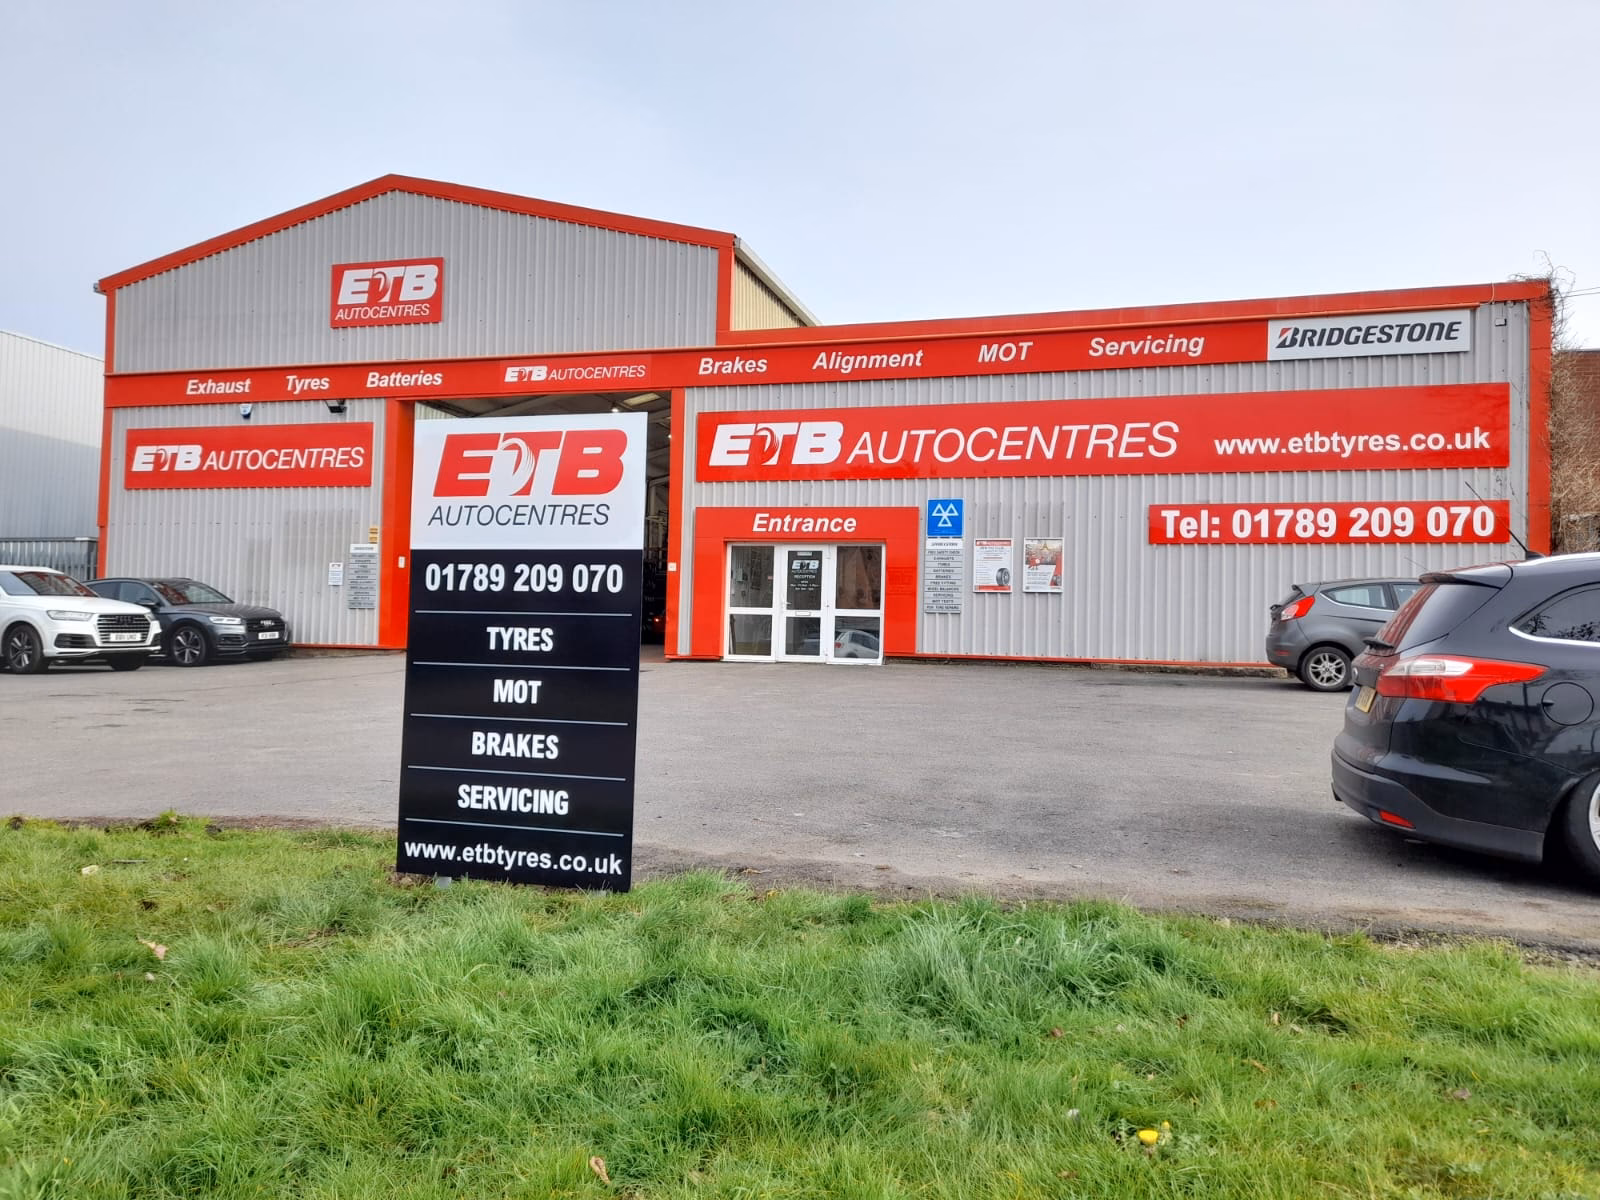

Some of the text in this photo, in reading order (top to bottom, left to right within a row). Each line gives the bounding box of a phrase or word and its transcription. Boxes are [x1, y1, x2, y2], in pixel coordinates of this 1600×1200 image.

[337, 264, 439, 305] ETB
[335, 303, 430, 321] AUTOCENTRES
[1088, 335, 1205, 358] Servicing
[1275, 321, 1462, 349] BRIDGESTONE
[698, 356, 768, 375] Brakes
[812, 349, 923, 375] Alignment
[977, 341, 1033, 364] MOT
[186, 378, 251, 395] Exhaust
[286, 375, 330, 395] Tyres
[366, 369, 443, 388] Batteries
[504, 364, 646, 383] ETB AUTOCENTRES
[708, 420, 1180, 467] ETB AUTOCENTRES
[1214, 426, 1491, 458] www.etbtyres.co.uk
[131, 444, 365, 472] ETB AUTOCENTRES
[433, 429, 628, 497] ETB
[427, 503, 611, 527] AUTOCENTRES
[752, 512, 857, 533] Entrance
[1161, 505, 1495, 539] Tel: 01789 209 070
[425, 563, 624, 593] 01789 209 070
[486, 626, 554, 652] TYRES
[493, 679, 542, 704] MOT
[471, 731, 559, 759] BRAKES
[457, 784, 569, 816] SERVICING
[404, 841, 623, 876] www.etbtyres.co.uk
